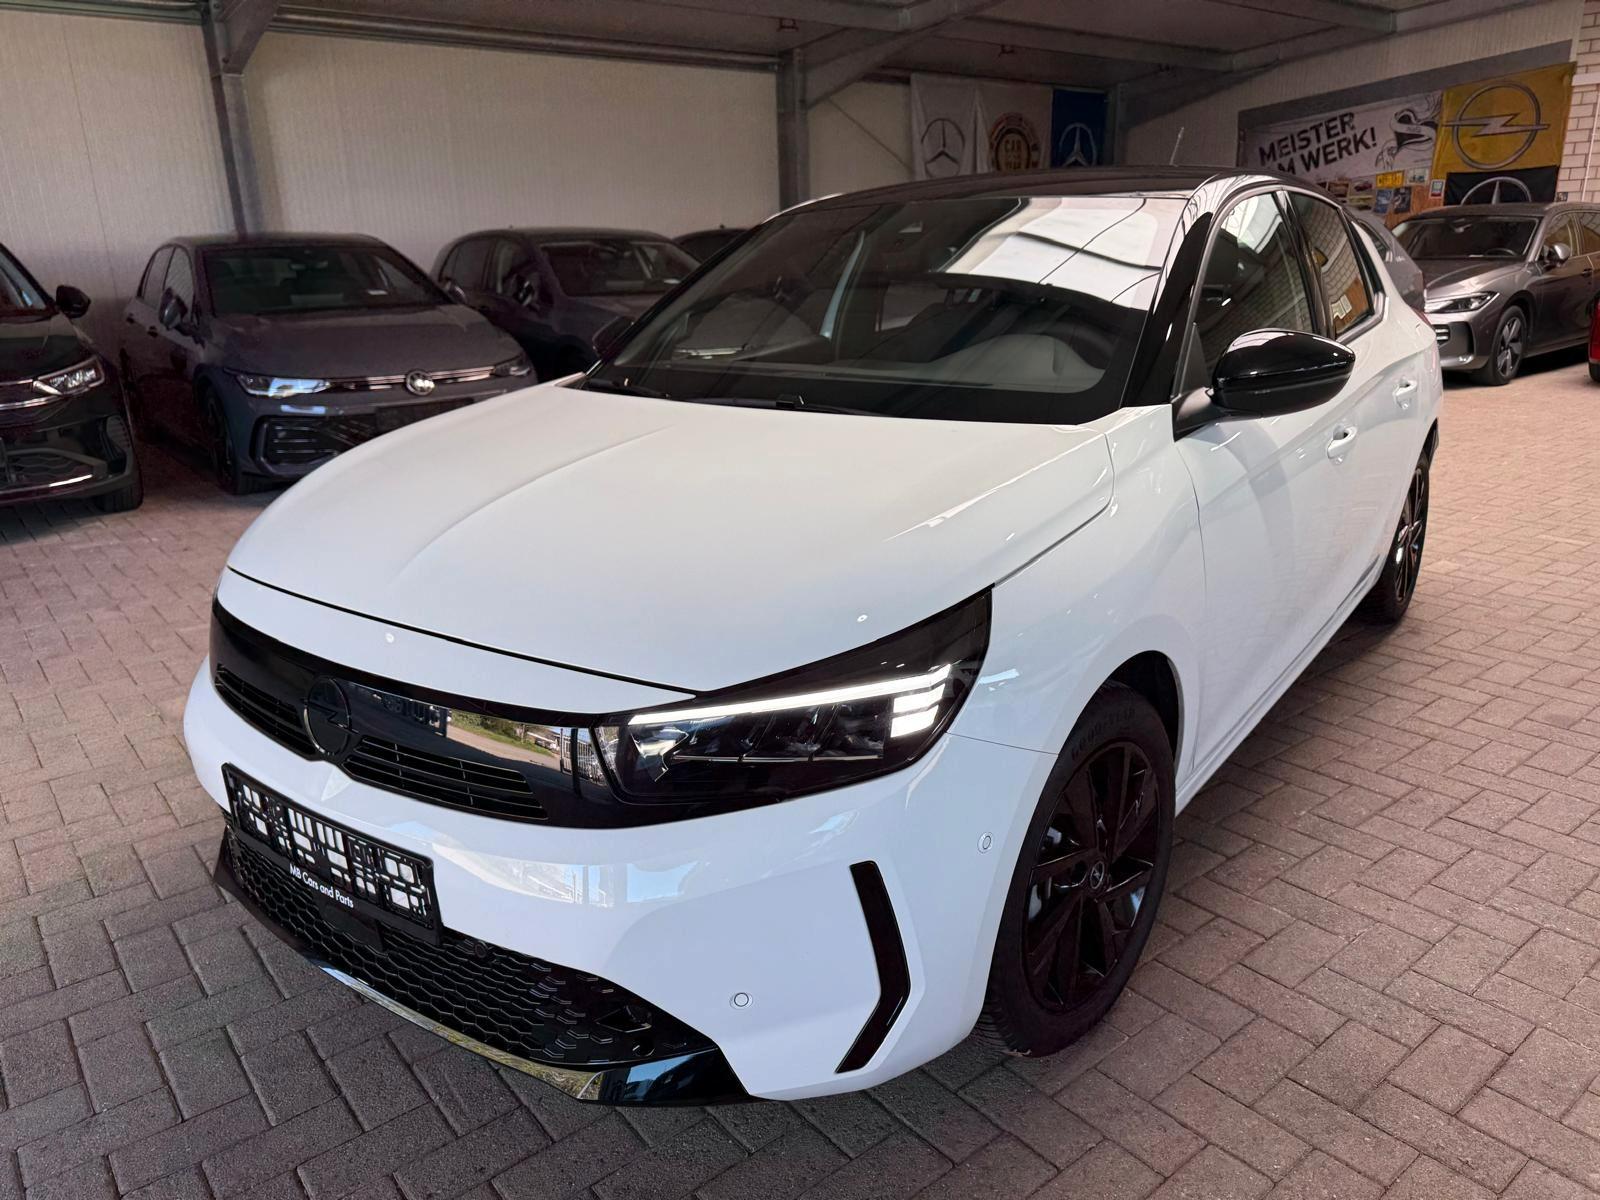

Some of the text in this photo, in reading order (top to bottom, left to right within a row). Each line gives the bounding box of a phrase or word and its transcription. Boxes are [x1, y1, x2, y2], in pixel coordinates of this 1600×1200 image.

[1258, 111, 1356, 168] MEISTER
[1300, 126, 1377, 172] WERK!
[289, 862, 354, 909] MB Cars and Parts
